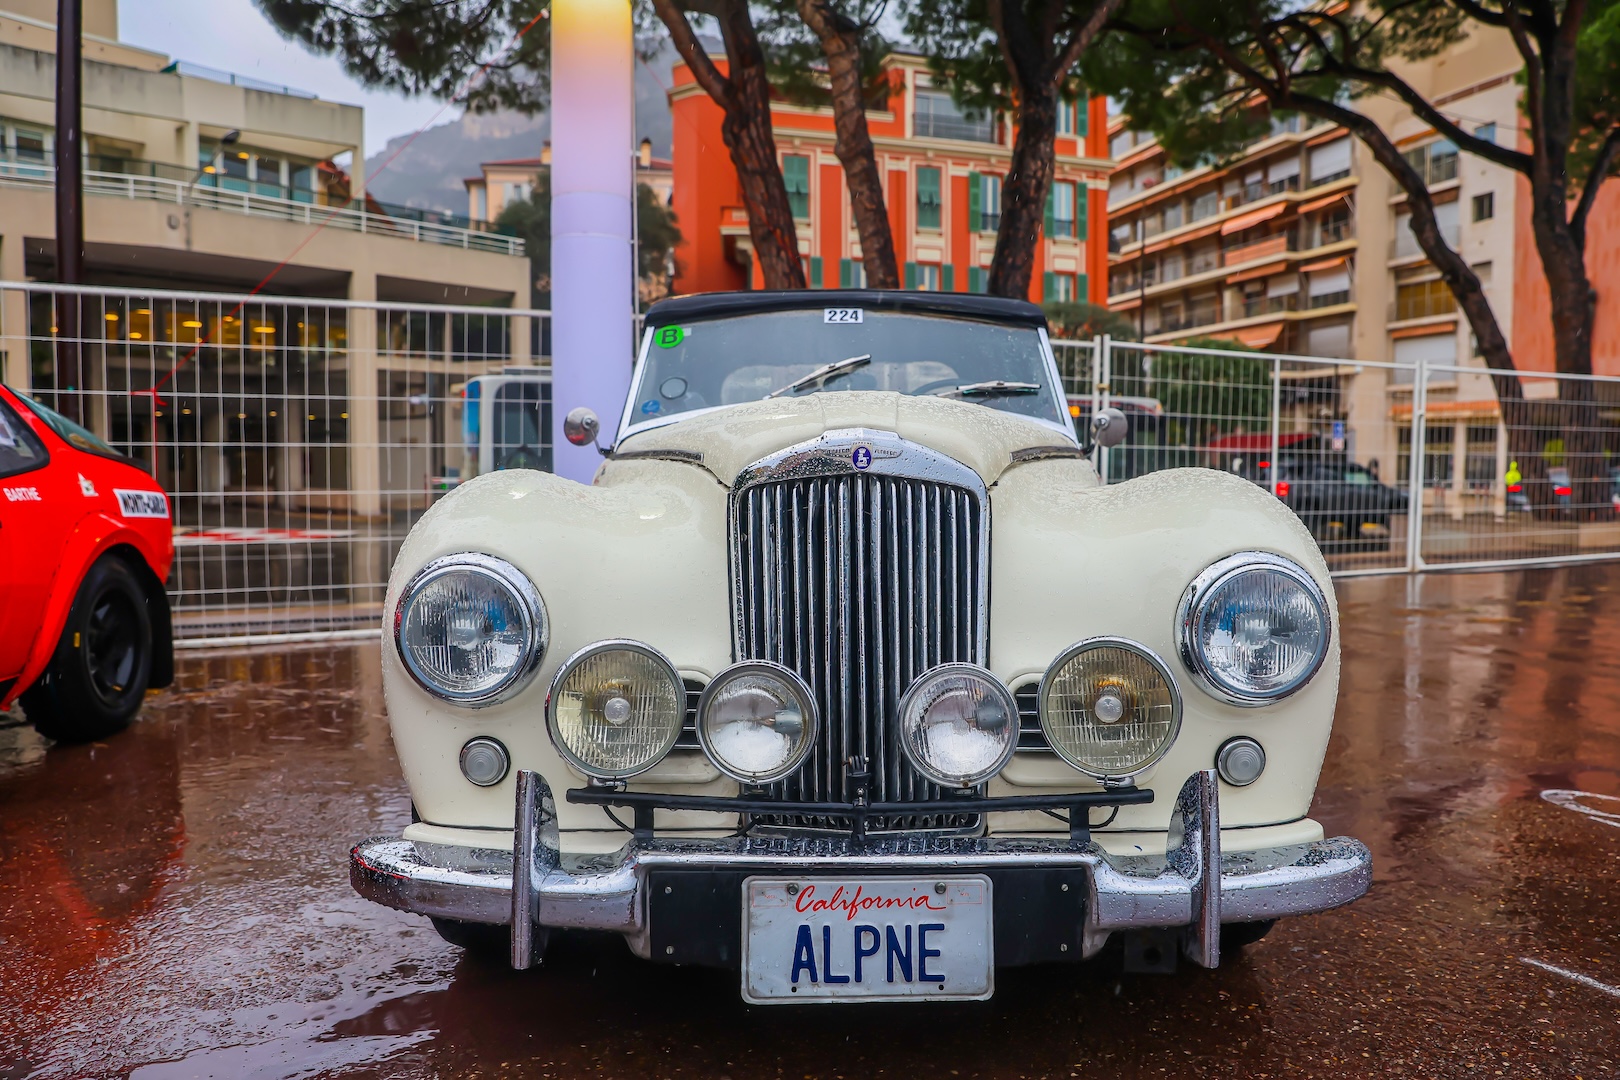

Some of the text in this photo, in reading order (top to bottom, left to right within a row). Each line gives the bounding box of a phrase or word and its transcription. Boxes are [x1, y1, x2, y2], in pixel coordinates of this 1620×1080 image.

[828, 310, 859, 321] 224
[661, 328, 678, 345] B
[795, 885, 947, 921] California
[791, 923, 946, 984] ALPNE
